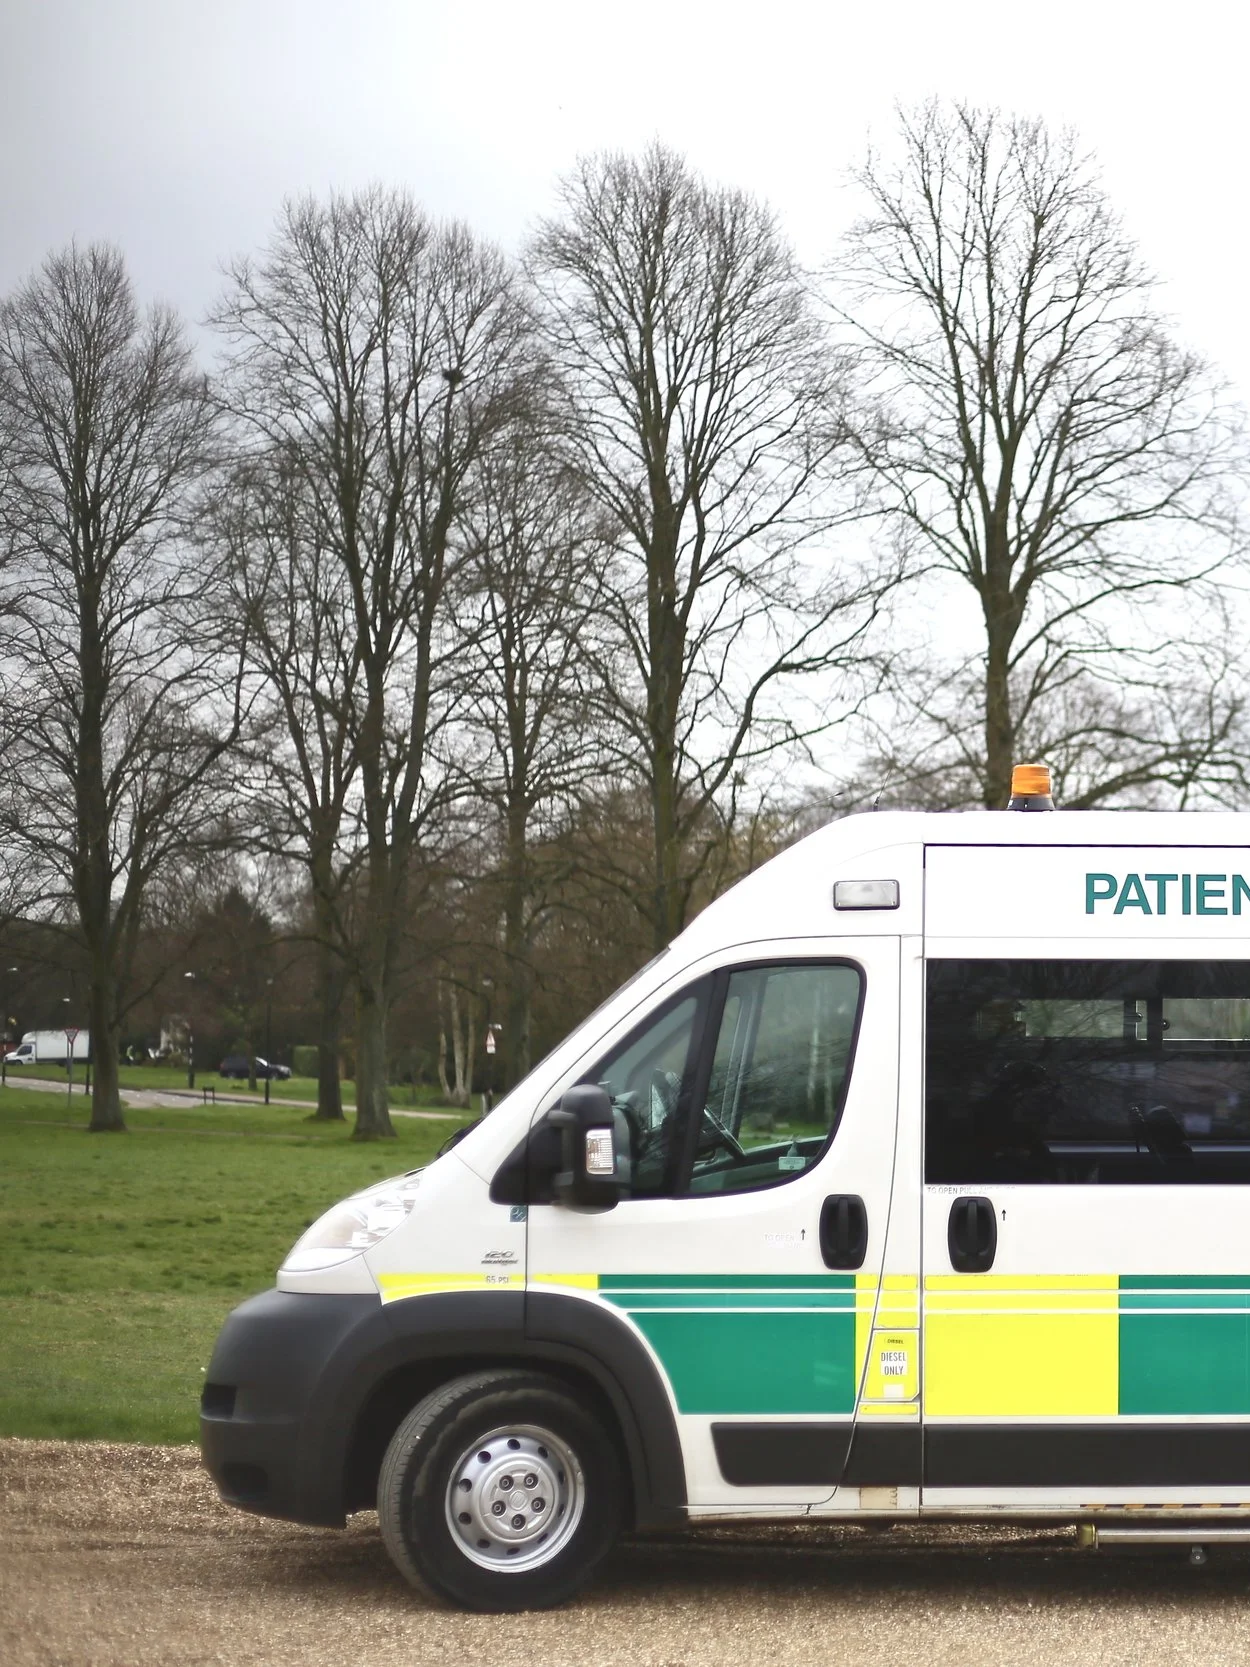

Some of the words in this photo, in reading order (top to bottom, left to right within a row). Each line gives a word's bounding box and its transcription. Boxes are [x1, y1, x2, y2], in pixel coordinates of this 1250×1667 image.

[498, 1276, 509, 1284] PSI
[881, 1352, 906, 1361] DIESEL
[884, 1365, 904, 1375] ONLY
